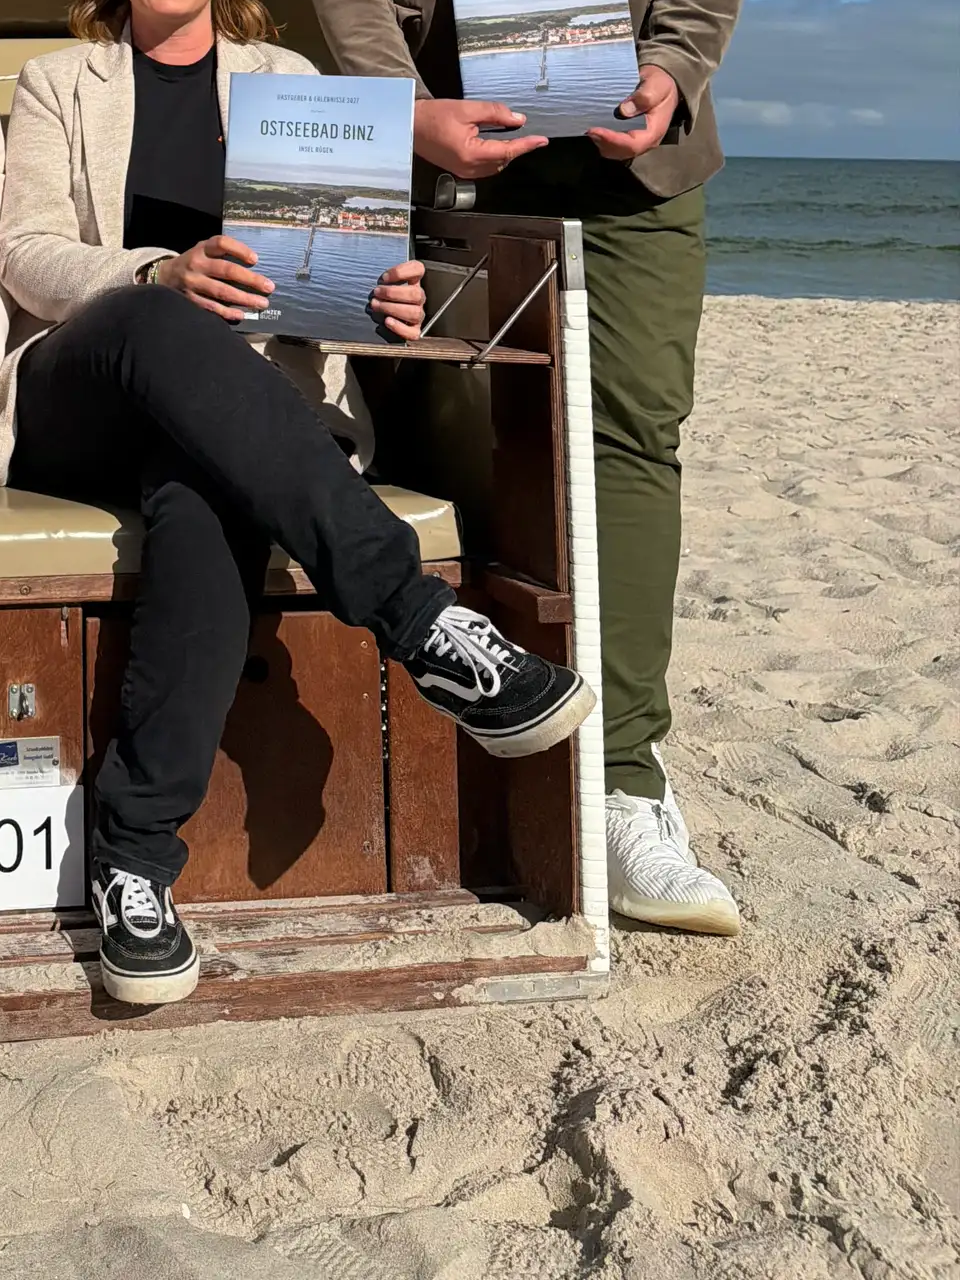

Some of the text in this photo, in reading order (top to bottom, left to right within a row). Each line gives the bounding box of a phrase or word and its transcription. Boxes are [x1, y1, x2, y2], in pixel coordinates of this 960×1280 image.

[260, 119, 374, 141] OSTSEEBAD BINZ
[298, 145, 334, 154] INSEL RÜGEN
